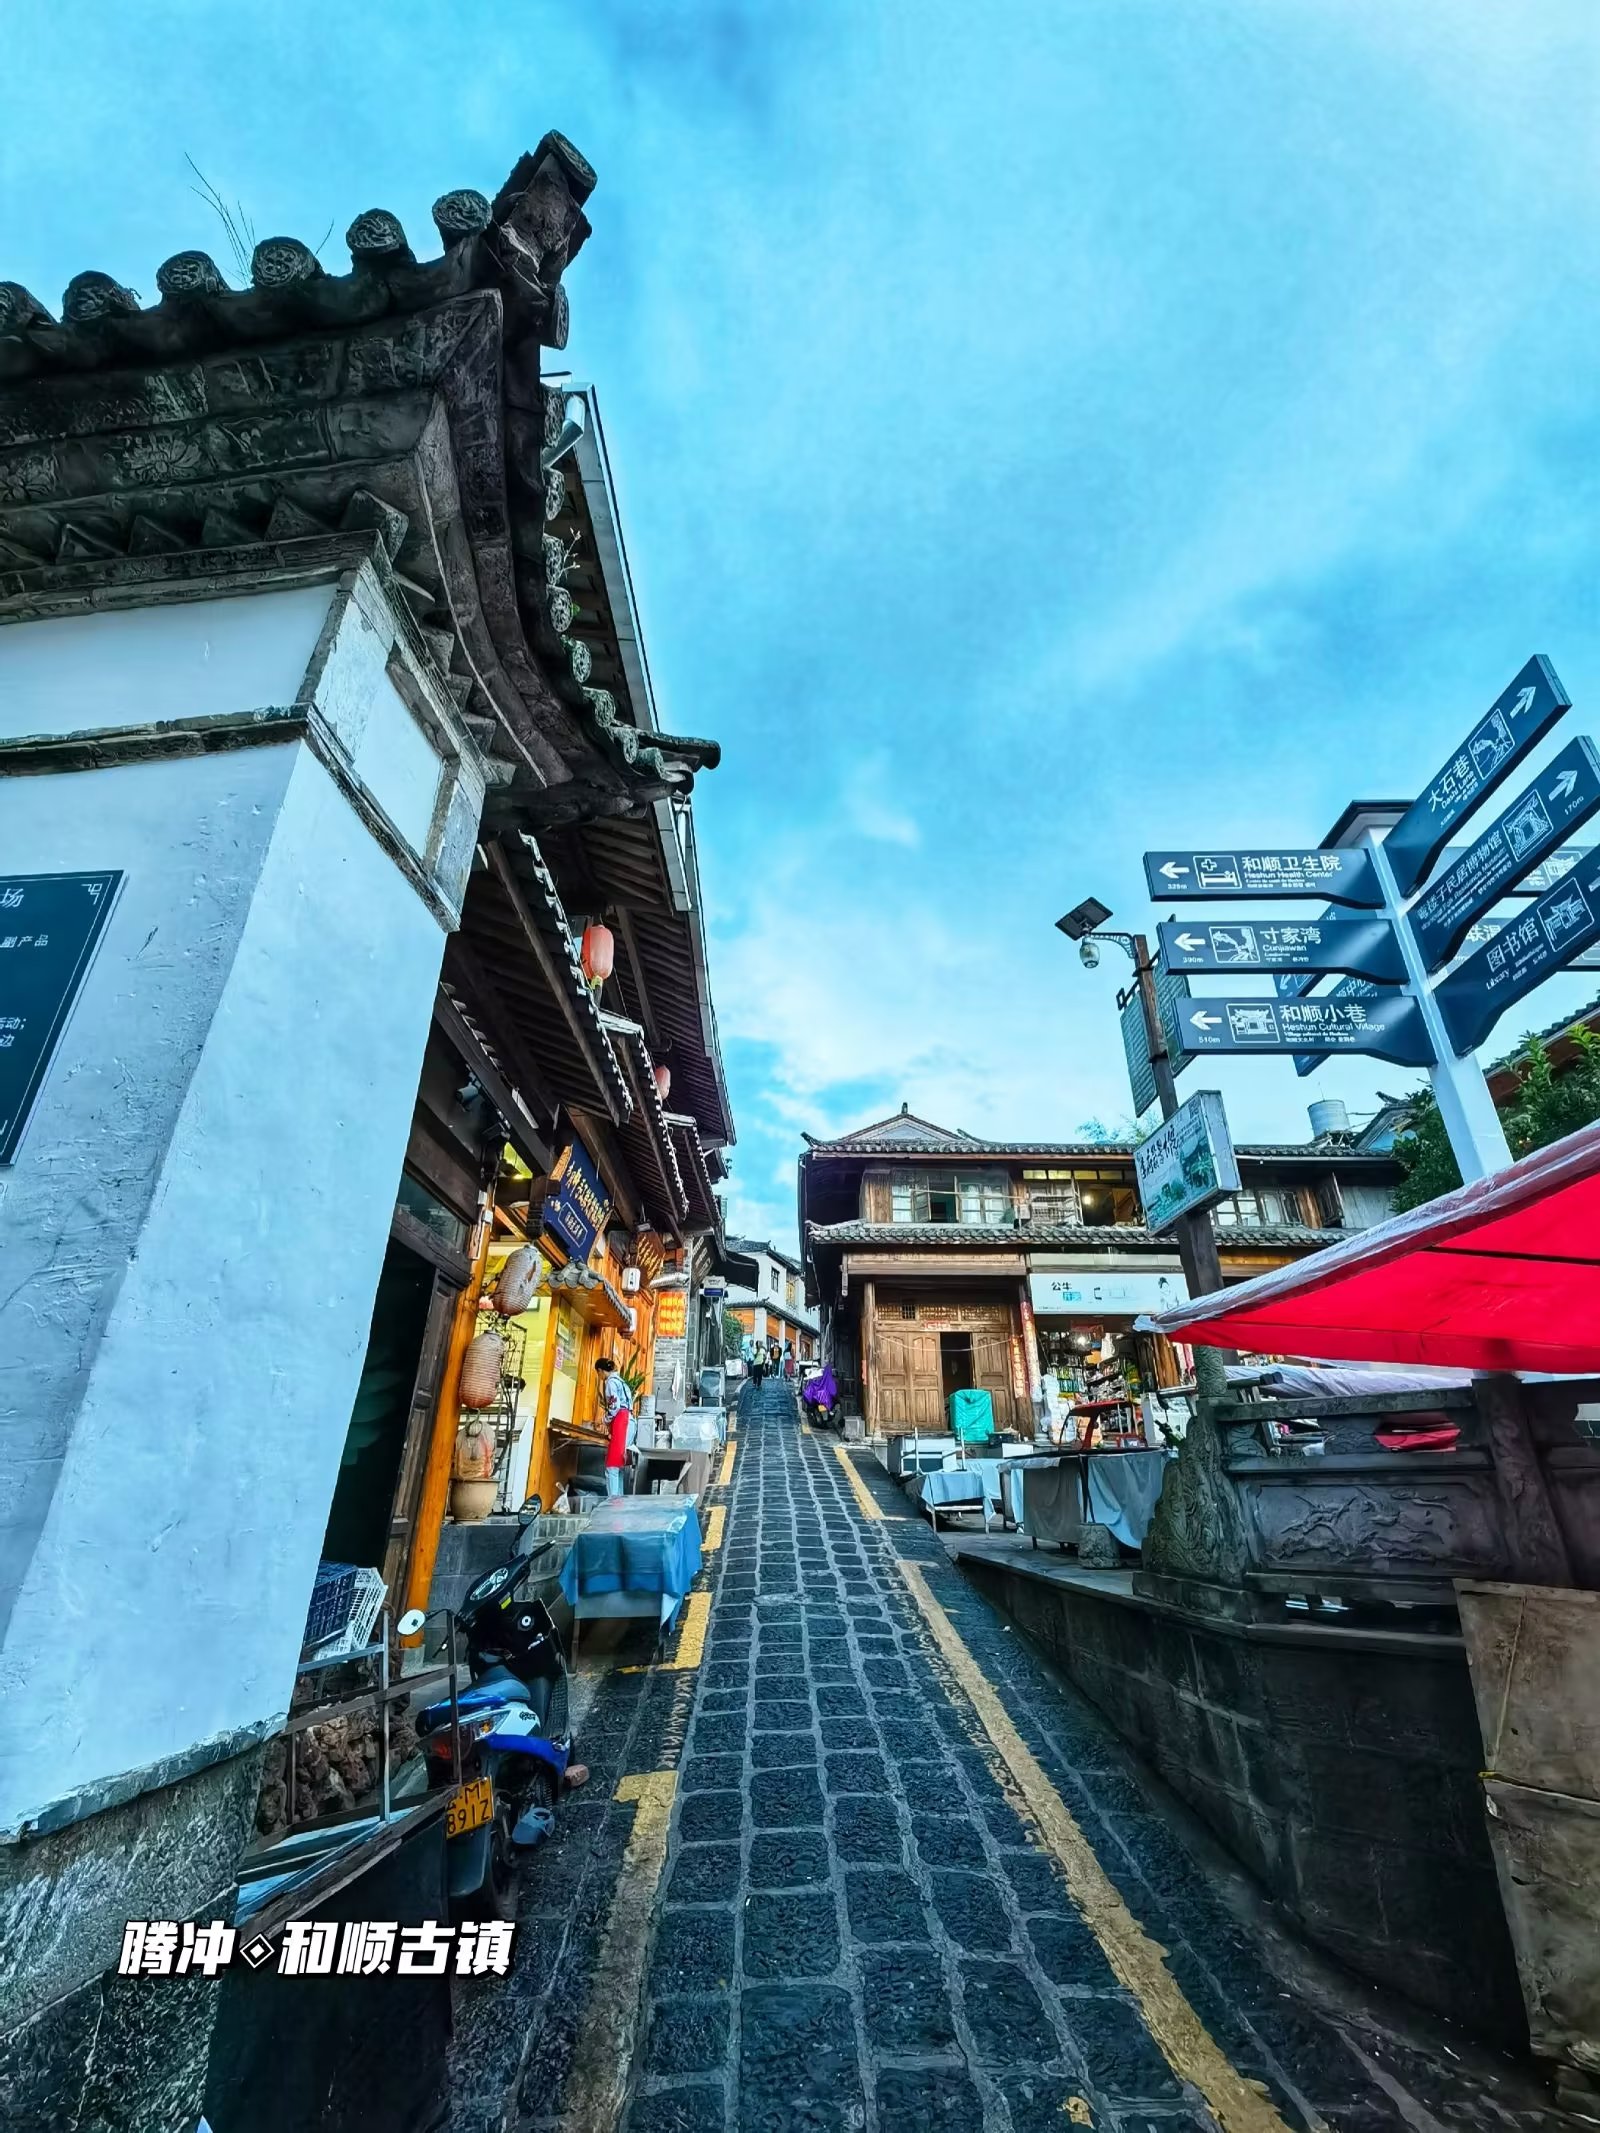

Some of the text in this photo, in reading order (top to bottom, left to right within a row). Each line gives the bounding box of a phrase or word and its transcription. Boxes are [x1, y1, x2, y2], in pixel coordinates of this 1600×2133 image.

[1427, 754, 1470, 813] 大石巷
[1241, 855, 1342, 872] 和顺卫生院
[1259, 926, 1322, 945] 寸家湾
[1486, 916, 1540, 973] 图书馆
[1182, 956, 1204, 964] 390m
[1486, 967, 1510, 990] Library
[1278, 1003, 1367, 1024] 和顺小巷
[1281, 1022, 1386, 1033] Heshun Cultural Village
[1198, 1035, 1221, 1044] 510m
[1051, 1281, 1073, 1291] 公牛
